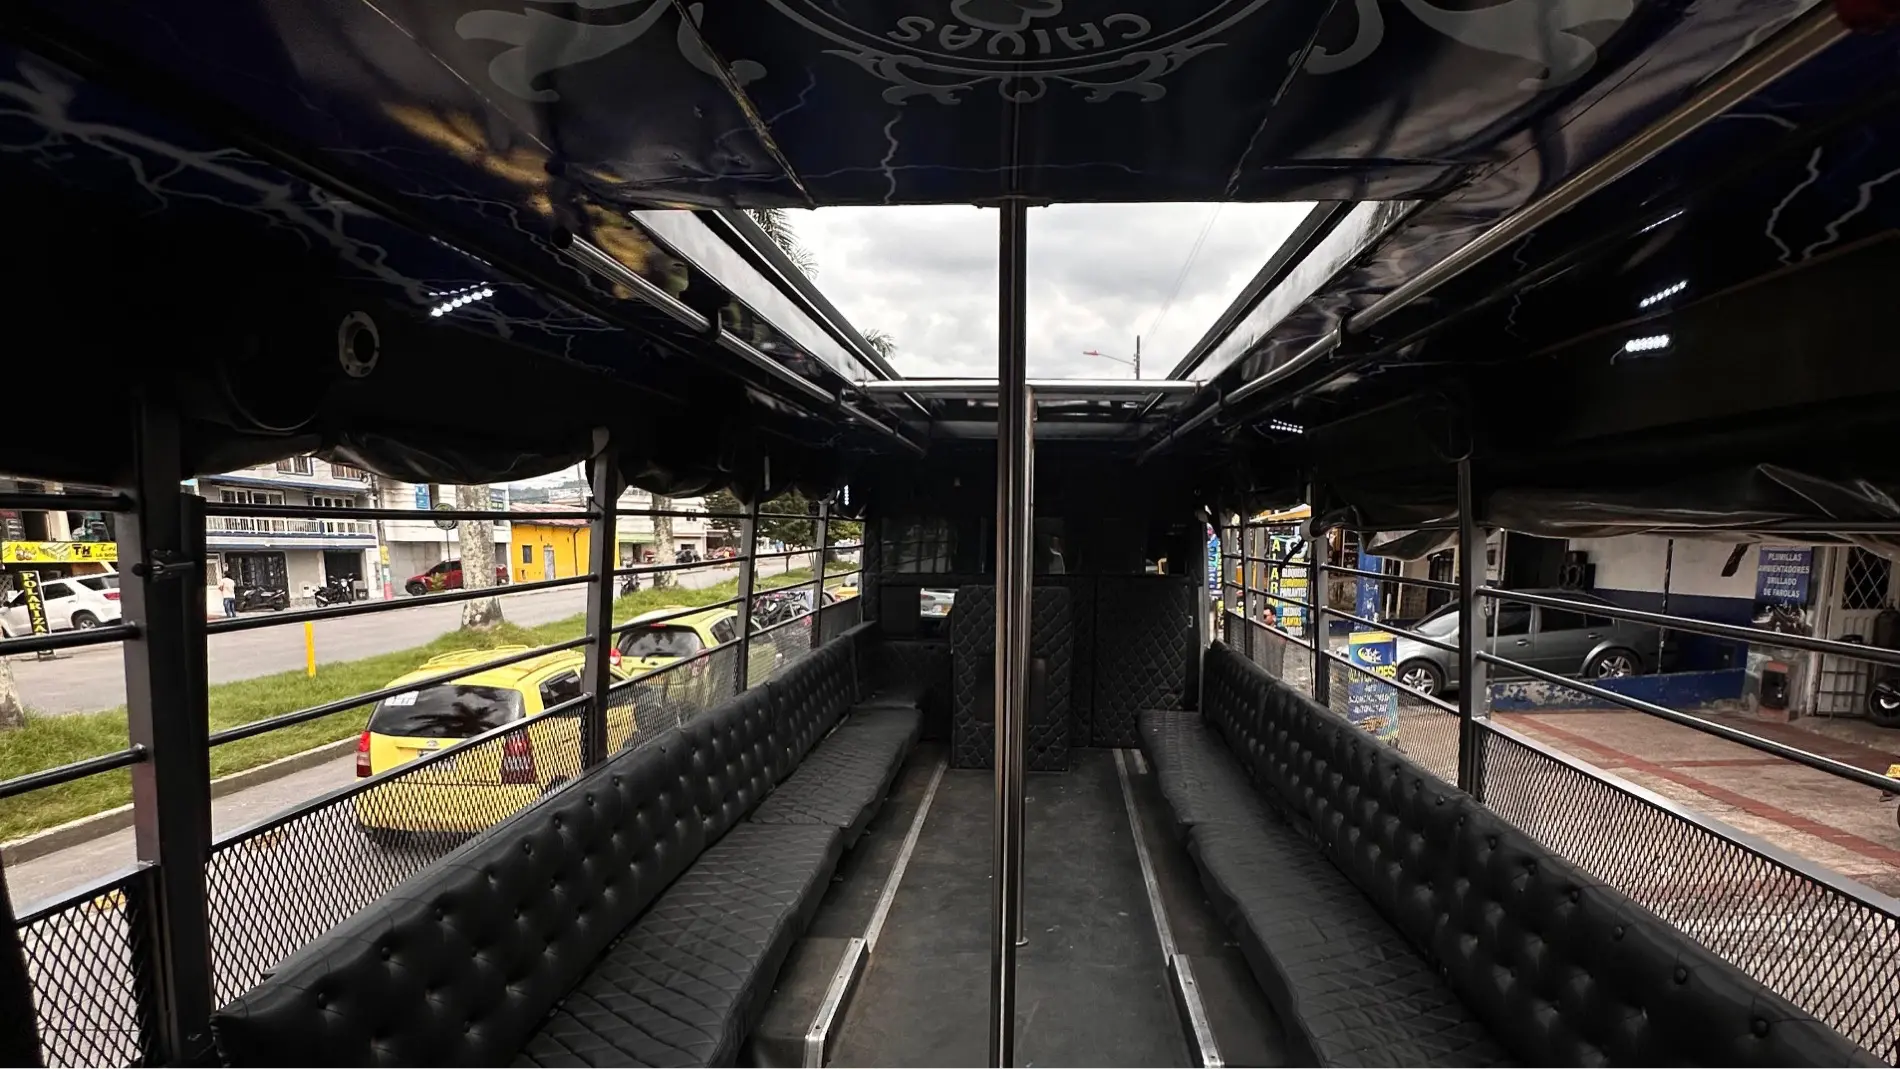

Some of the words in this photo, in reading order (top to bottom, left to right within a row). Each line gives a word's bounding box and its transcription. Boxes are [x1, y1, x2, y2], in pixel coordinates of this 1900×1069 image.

[886, 13, 1151, 55] CHIVAS
[1768, 552, 1802, 562] PLUMILLAS
[22, 572, 48, 635] POLARIZA
[1763, 588, 1772, 596] DE
